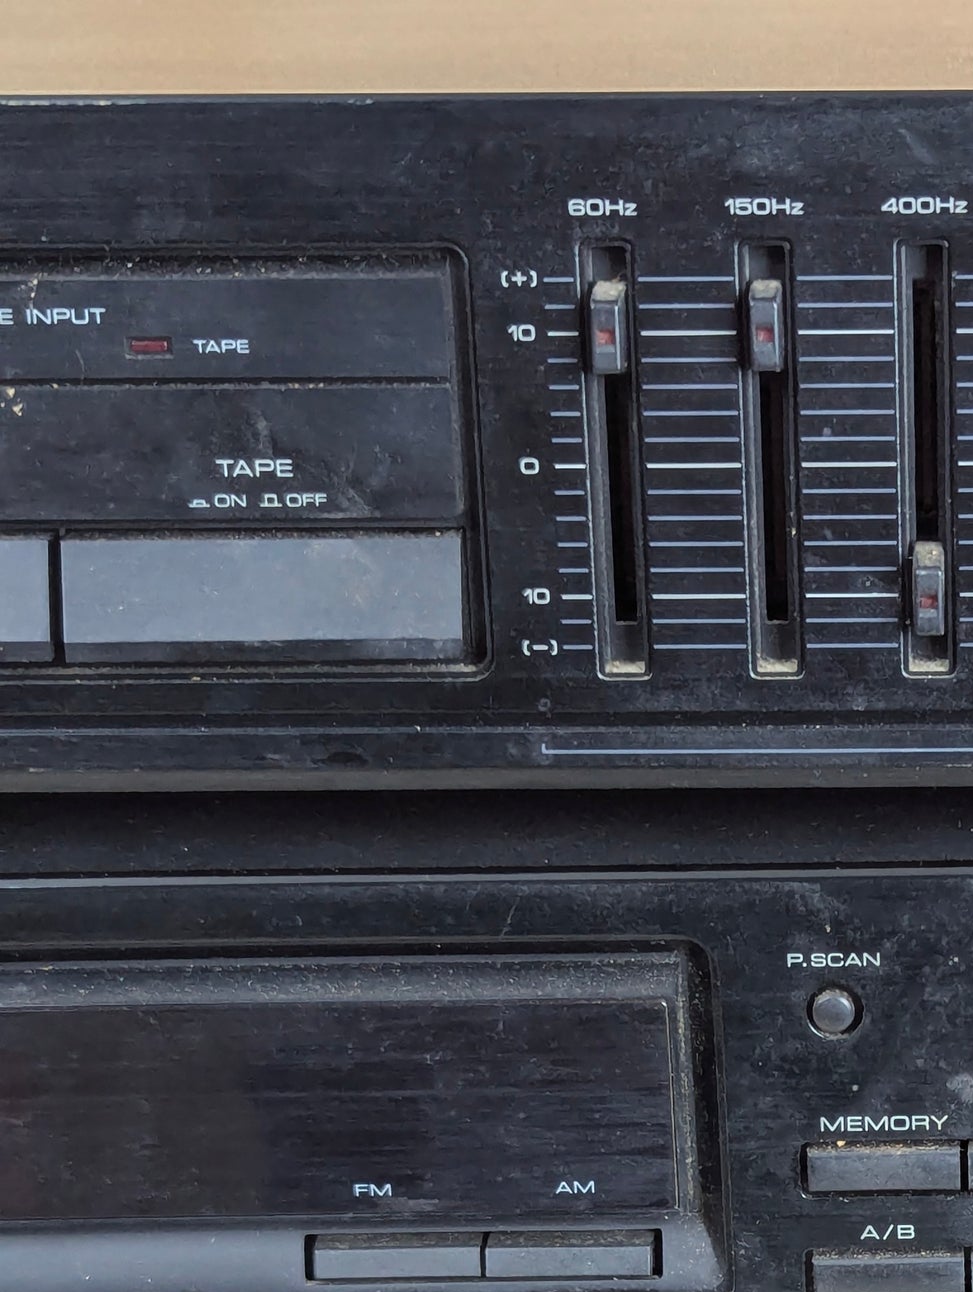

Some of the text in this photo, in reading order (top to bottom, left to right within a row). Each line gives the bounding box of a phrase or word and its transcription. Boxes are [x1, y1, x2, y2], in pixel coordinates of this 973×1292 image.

[568, 199, 637, 215] 60Hz
[725, 198, 803, 215] 150Hz
[881, 197, 967, 214] 400Hz
[25, 308, 105, 325] INPUT
[508, 325, 535, 341] 10
[193, 340, 249, 353] TAPE
[216, 459, 293, 477] TAPE
[520, 458, 539, 474] 0
[215, 493, 326, 507] ON OFF
[524, 588, 550, 604] 10
[820, 1115, 948, 1131] MEMORY
[354, 1184, 391, 1196] FM
[556, 1181, 594, 1193] AM
[861, 1225, 914, 1240] A/B
